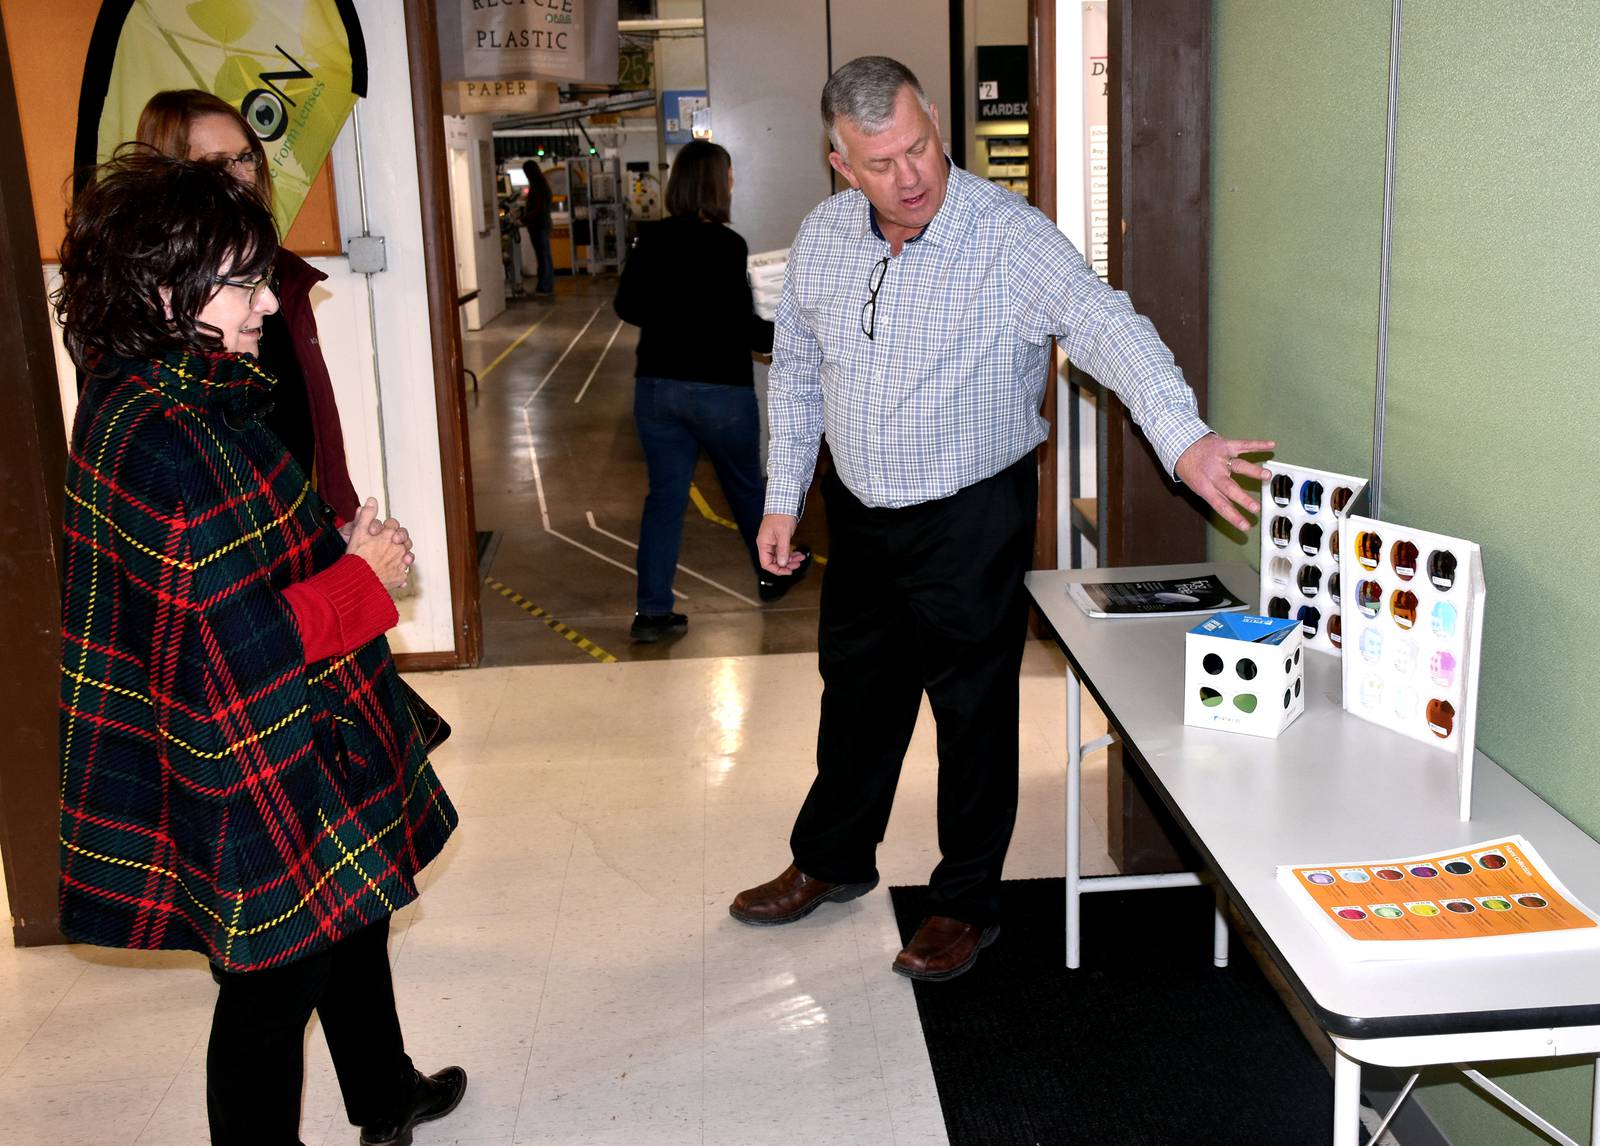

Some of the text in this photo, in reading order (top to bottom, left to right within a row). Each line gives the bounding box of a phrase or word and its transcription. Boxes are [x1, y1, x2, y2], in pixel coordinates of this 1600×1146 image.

[477, 30, 568, 49] PLASTIC
[467, 81, 528, 96] PAPER
[985, 84, 993, 97] 2
[983, 102, 1028, 116] KARDEX
[273, 80, 325, 166] Form Lenses
